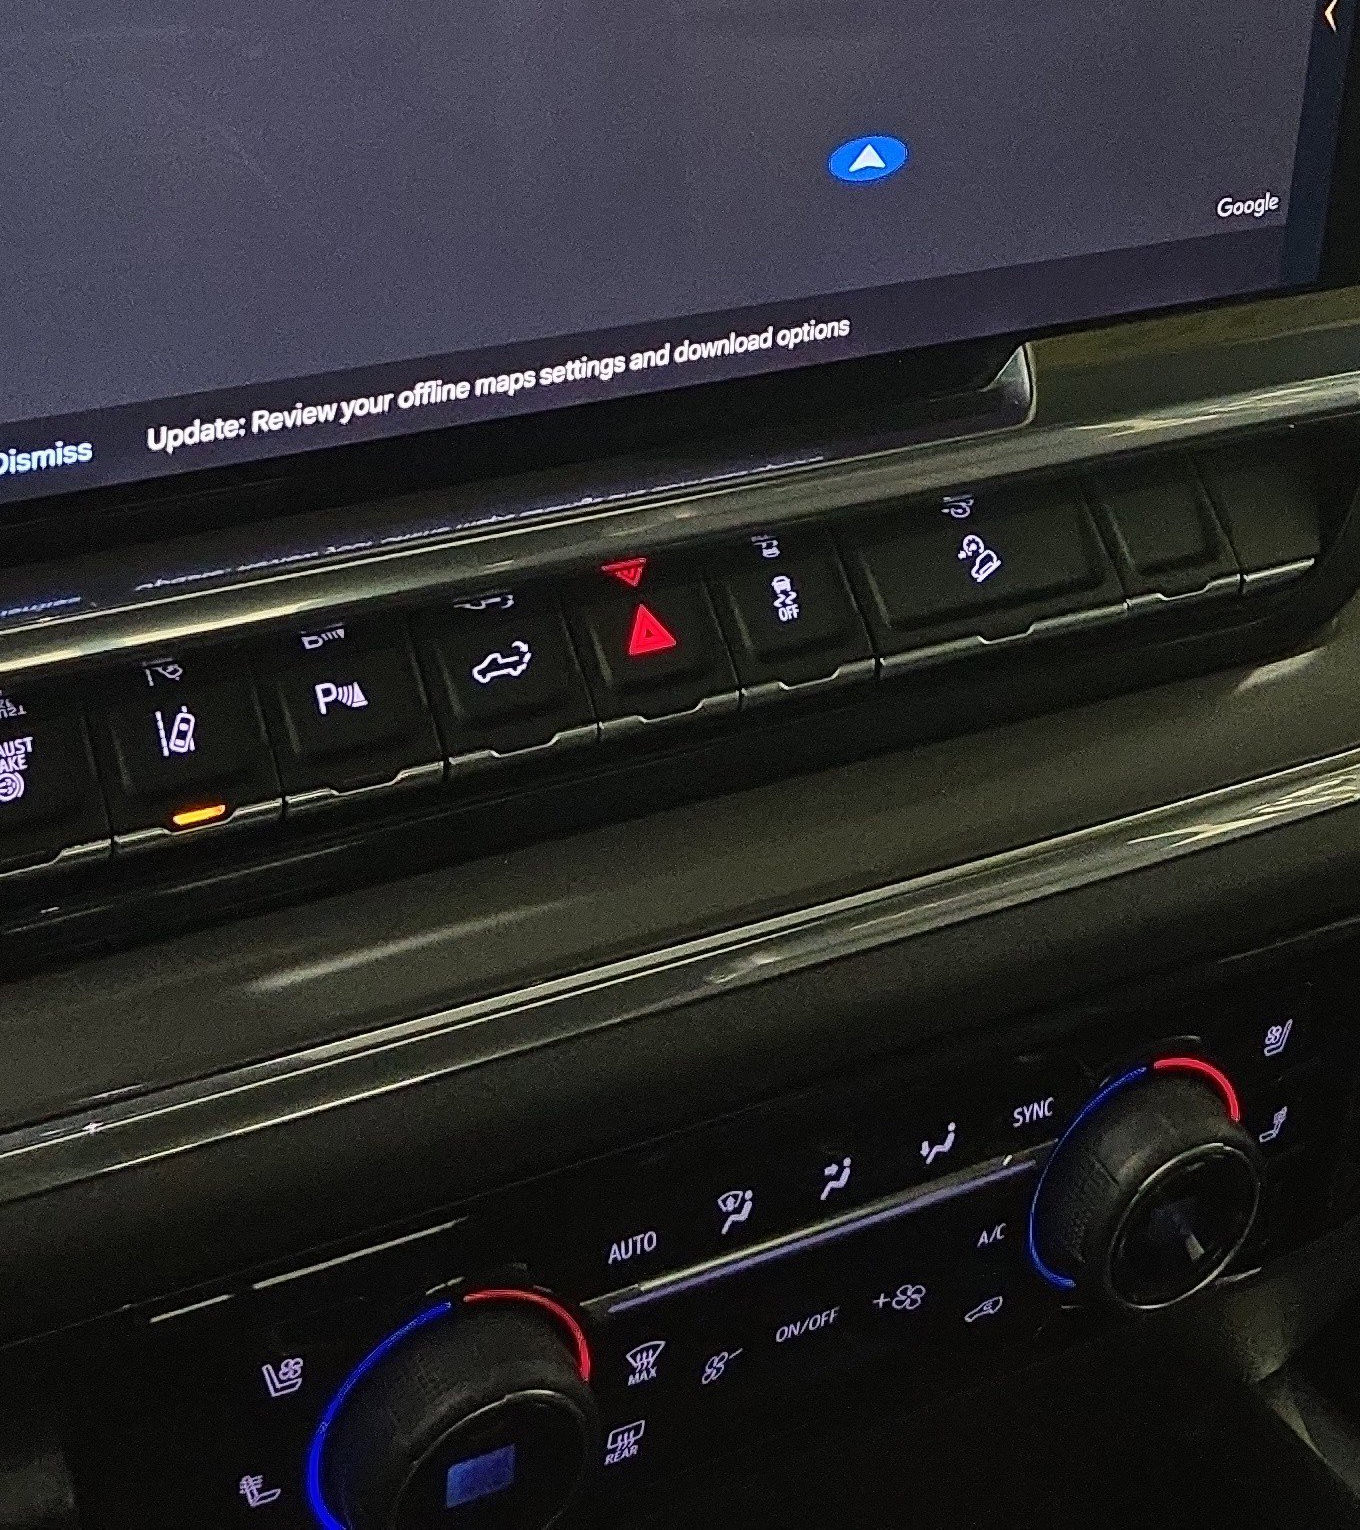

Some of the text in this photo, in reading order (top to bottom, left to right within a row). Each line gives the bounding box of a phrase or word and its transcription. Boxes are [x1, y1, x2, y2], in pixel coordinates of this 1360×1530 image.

[1216, 191, 1280, 219] Google
[147, 318, 851, 454] Update: Review your offline maps settings and download options
[778, 603, 800, 622] OFF
[1012, 1096, 1055, 1128] SYNC
[607, 1230, 658, 1265] AUTO
[976, 1222, 1007, 1249] A/C
[775, 1306, 841, 1343] ON/OFF
[627, 1367, 658, 1387] MAX
[603, 1443, 639, 1466] REAR
